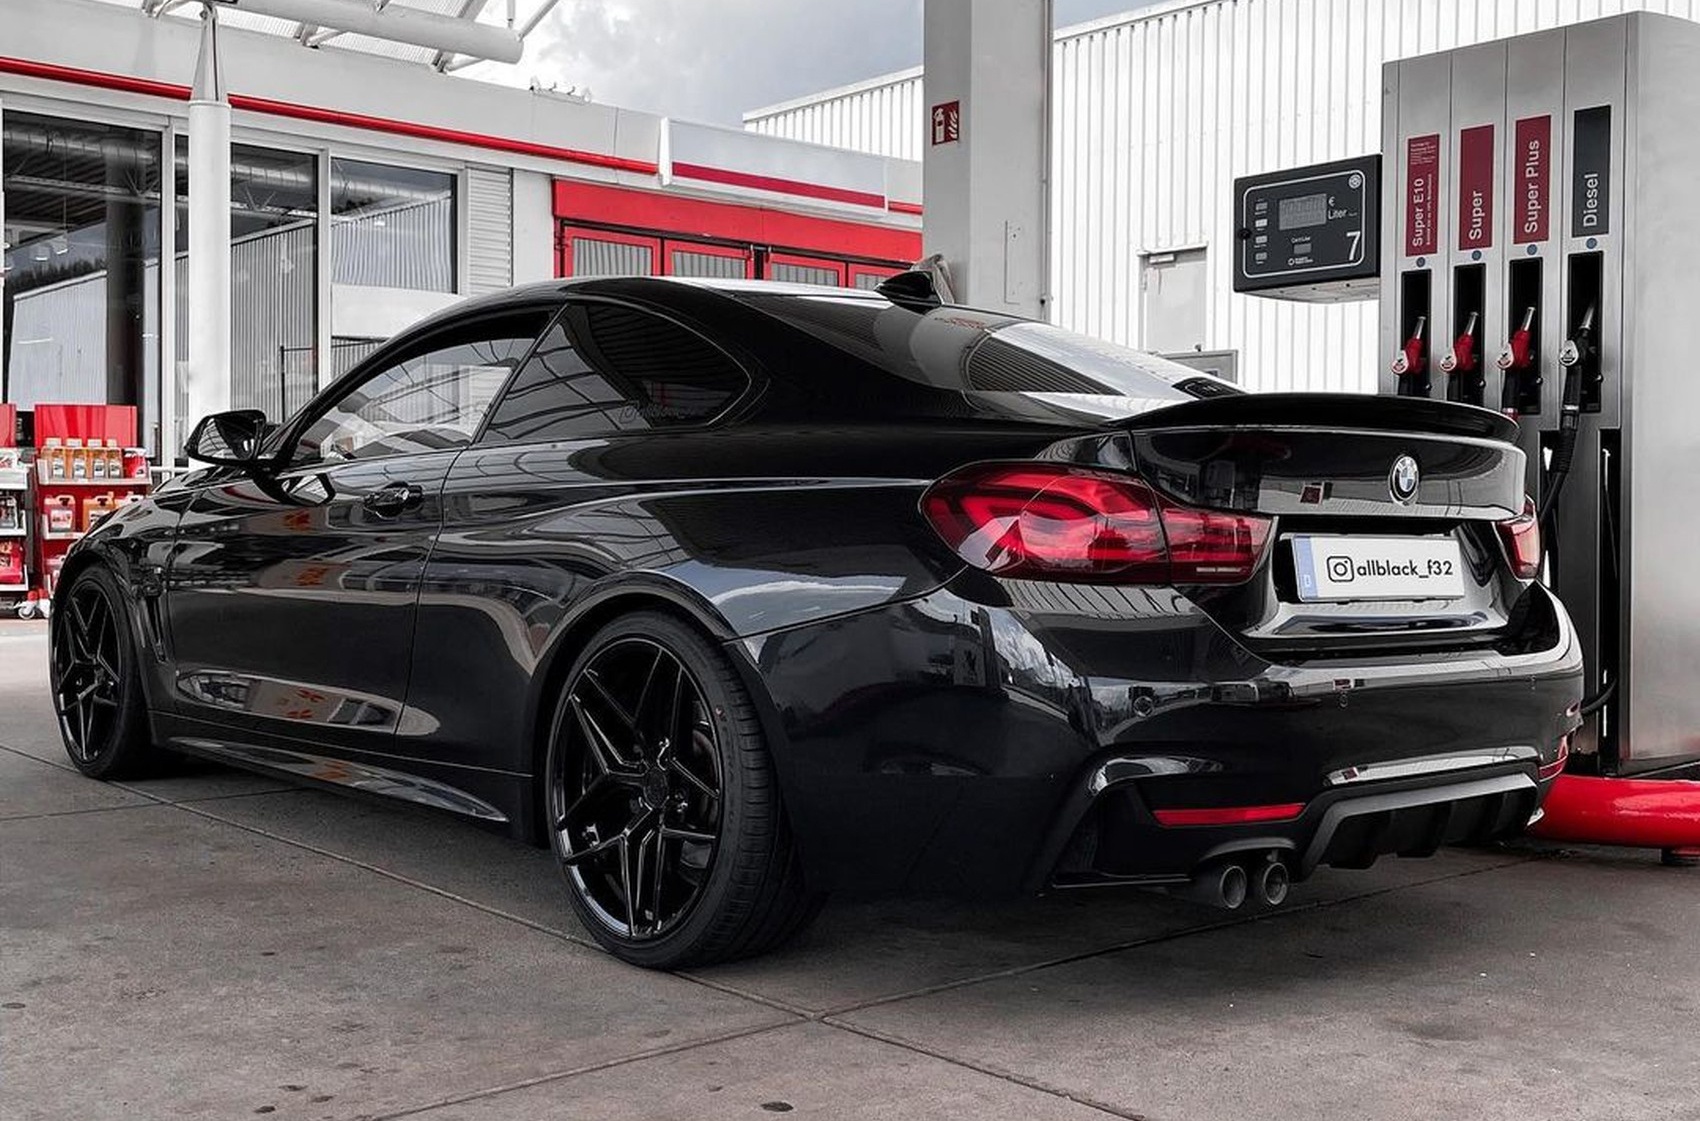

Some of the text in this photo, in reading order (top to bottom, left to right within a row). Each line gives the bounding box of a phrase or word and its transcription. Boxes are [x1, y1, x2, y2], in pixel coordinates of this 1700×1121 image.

[1413, 178, 1425, 204] E10
[1524, 140, 1542, 233] Super Plus
[1583, 173, 1599, 227] Diesel
[1412, 207, 1425, 247] Super
[1468, 190, 1486, 240] Super
[1346, 231, 1361, 261] 7
[1356, 559, 1453, 580] allblack_f32
